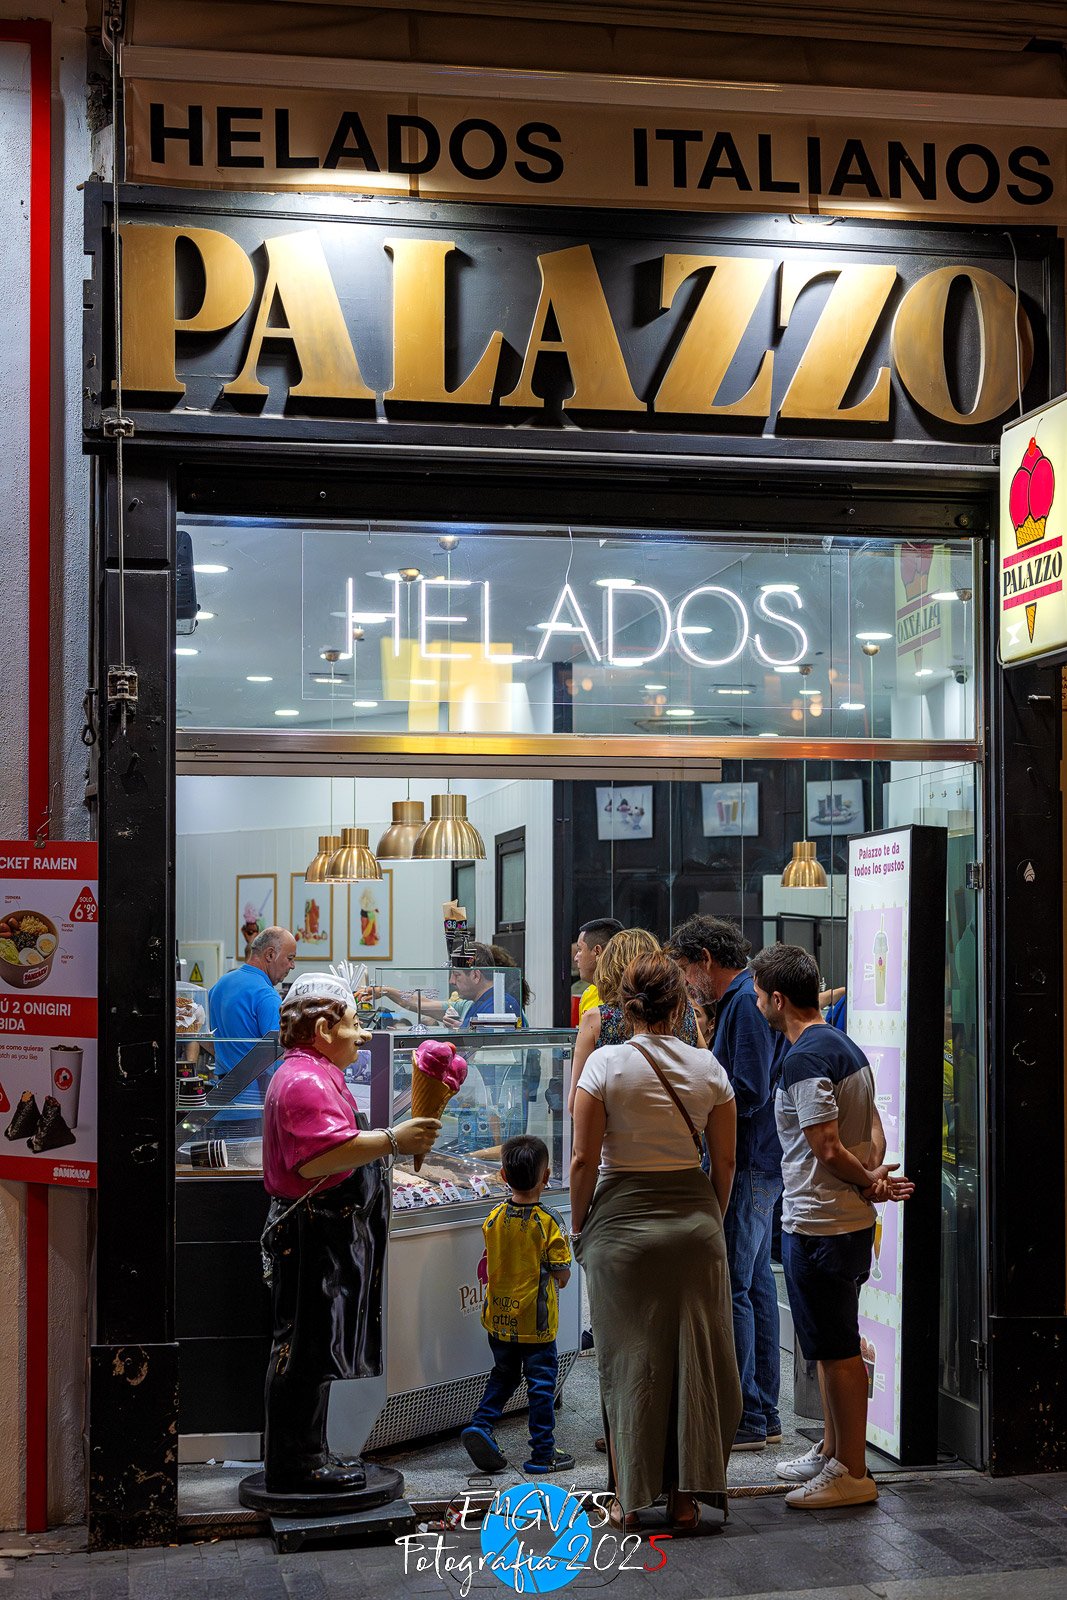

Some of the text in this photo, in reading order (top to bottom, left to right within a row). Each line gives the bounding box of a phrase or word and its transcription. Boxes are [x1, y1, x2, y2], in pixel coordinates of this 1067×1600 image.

[149, 102, 1055, 206] HELADOS ITALIANOS
[111, 224, 1035, 426] PALAZZO
[1003, 550, 1063, 598] PALAZZO
[345, 576, 808, 666] HELADOS
[33, 857, 77, 870] RAMEN
[858, 842, 900, 860] Palazzo te da
[854, 860, 905, 877] todos los gustos
[12, 1001, 21, 1014] 2
[23, 1001, 72, 1017] ONIGIRI
